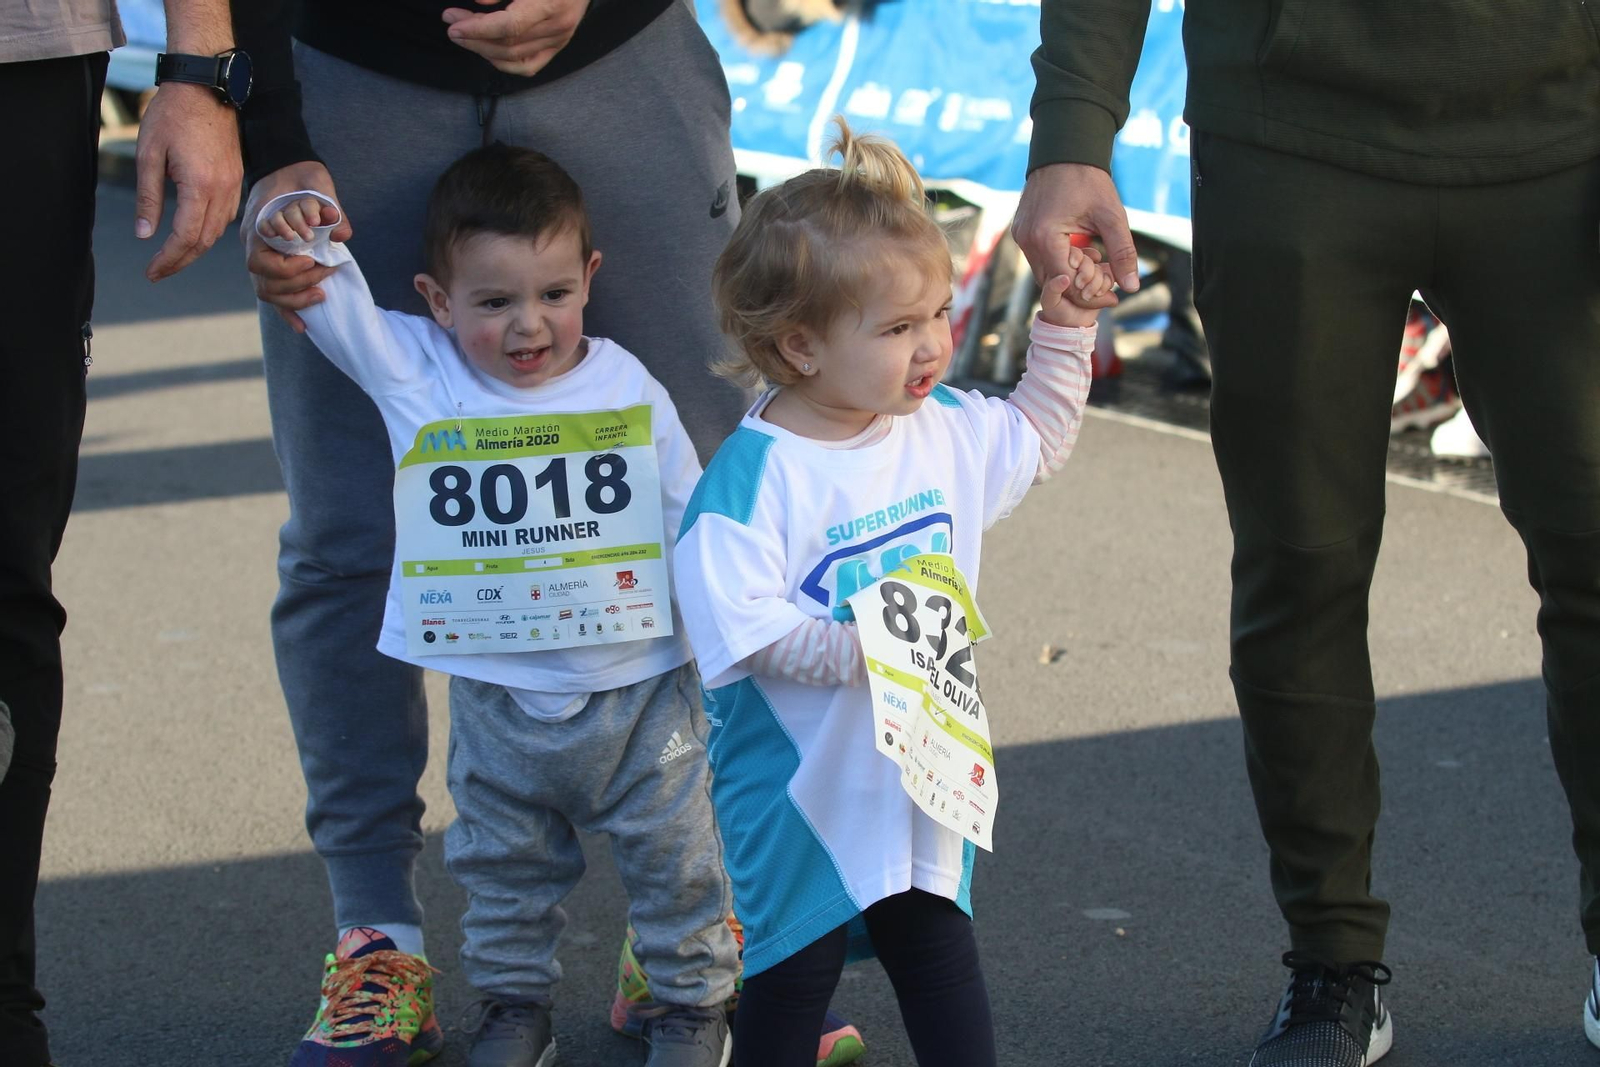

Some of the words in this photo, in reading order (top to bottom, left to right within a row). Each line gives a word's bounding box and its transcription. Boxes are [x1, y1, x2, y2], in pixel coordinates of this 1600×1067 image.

[475, 427, 509, 438] Medio
[514, 423, 561, 435] Maratón
[594, 424, 628, 434] CARRERA
[595, 430, 628, 442] INFANTIL
[475, 434, 524, 450] Almería
[525, 434, 560, 447] 2020
[429, 453, 632, 527] 8018
[826, 509, 887, 546] SUPER
[887, 489, 945, 524] RUNNE
[462, 530, 507, 548] MINI
[515, 520, 601, 546] RUNNER
[521, 547, 546, 556] JESUS
[916, 559, 949, 573] Medio
[477, 585, 504, 601] CDX
[548, 578, 589, 592] ALMERÍA
[420, 590, 453, 605] NEXA
[879, 581, 986, 707] 832
[883, 691, 908, 714] NEXA
[943, 679, 980, 721] OLIVA
[659, 743, 692, 764] adidas
